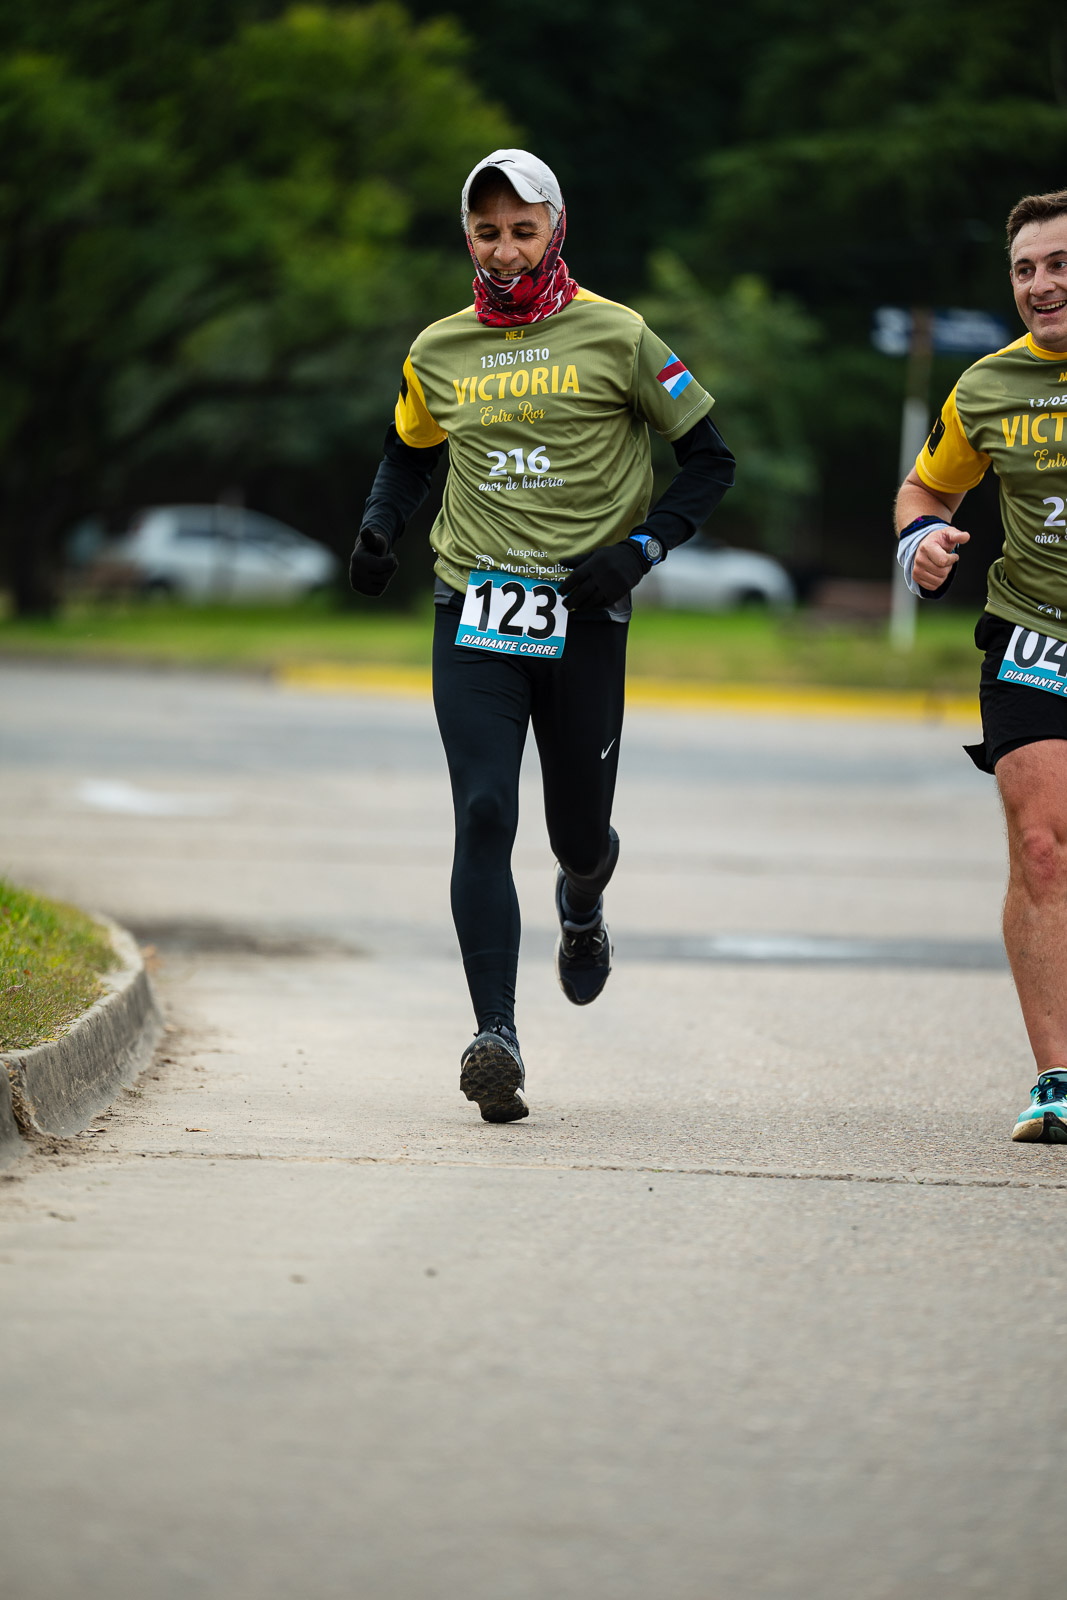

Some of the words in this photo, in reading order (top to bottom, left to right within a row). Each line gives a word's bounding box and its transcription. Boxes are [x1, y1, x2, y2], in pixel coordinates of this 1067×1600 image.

[505, 330, 524, 341] NEJ
[480, 347, 550, 369] 13/05/1810
[452, 364, 580, 406] VICTORIA
[480, 405, 515, 427] Entre
[1001, 411, 1067, 448] VICT
[486, 445, 551, 477] 216
[505, 475, 520, 491] de
[522, 474, 566, 489] historia
[1034, 532, 1060, 545] años
[506, 547, 548, 559] Auspicia:
[475, 579, 557, 641] 123
[461, 634, 519, 652] DIAMANTE
[519, 642, 558, 656] CORRE
[1003, 670, 1064, 692] DIAMANTE
